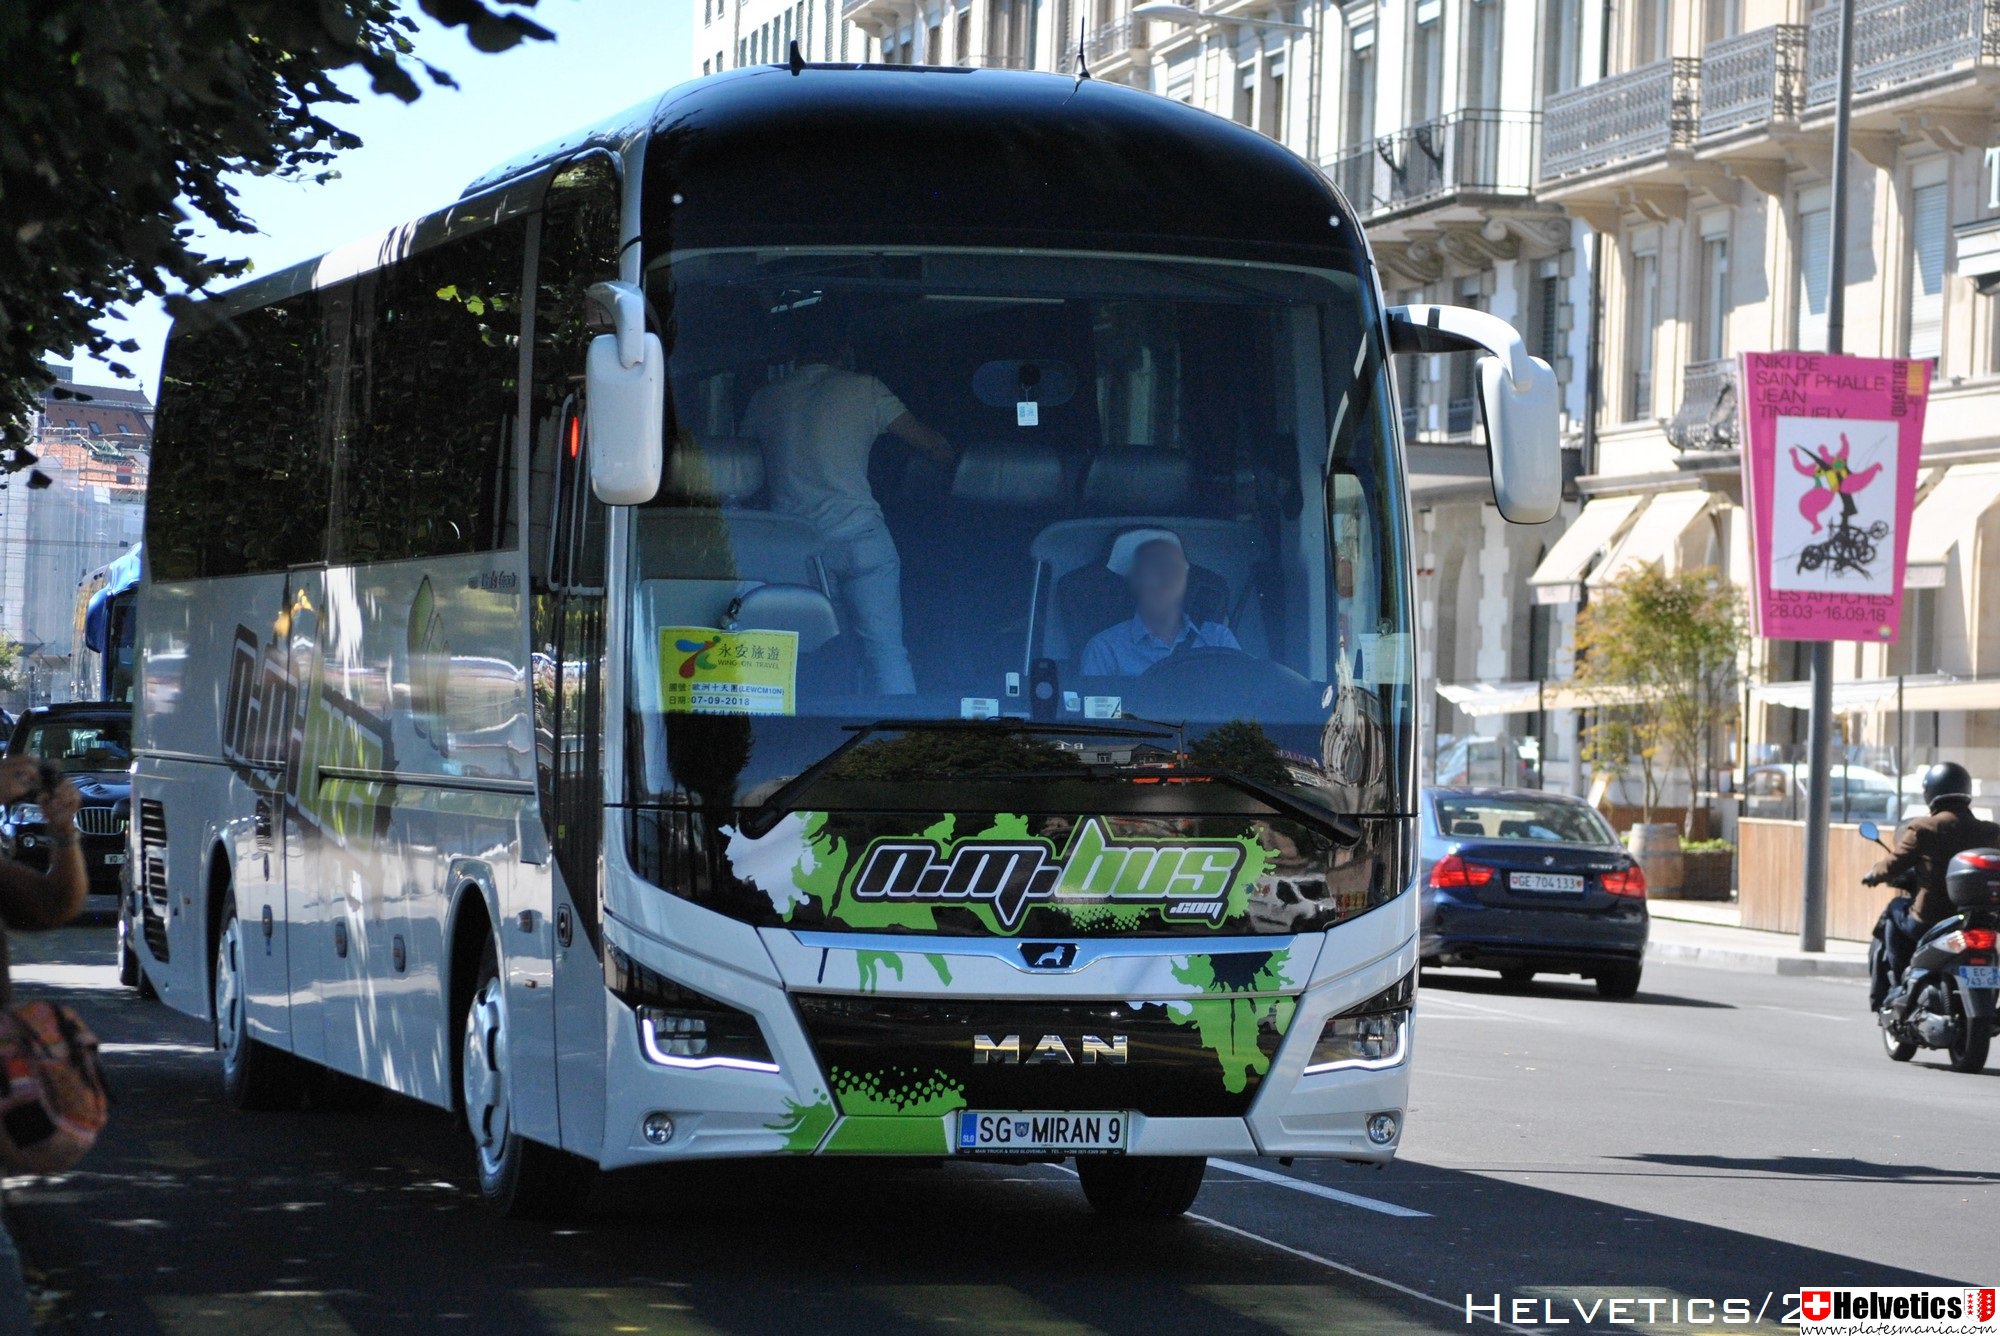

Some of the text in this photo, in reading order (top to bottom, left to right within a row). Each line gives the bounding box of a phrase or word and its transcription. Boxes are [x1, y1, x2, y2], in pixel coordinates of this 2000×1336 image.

[1754, 355, 1820, 371] NIKI DE
[1755, 371, 1885, 392] SAINT PHALLE
[1891, 361, 1907, 417] QUARTIER
[1757, 388, 1807, 403] JEAN
[718, 644, 780, 661] 永安旅遊
[717, 659, 738, 667] WING
[756, 661, 779, 669] TRAVEL
[691, 696, 750, 706] 07-09-2018
[974, 1035, 1128, 1064] MAN
[980, 1117, 1121, 1143] SG MIRAN 9
[963, 1135, 975, 1143] SLO
